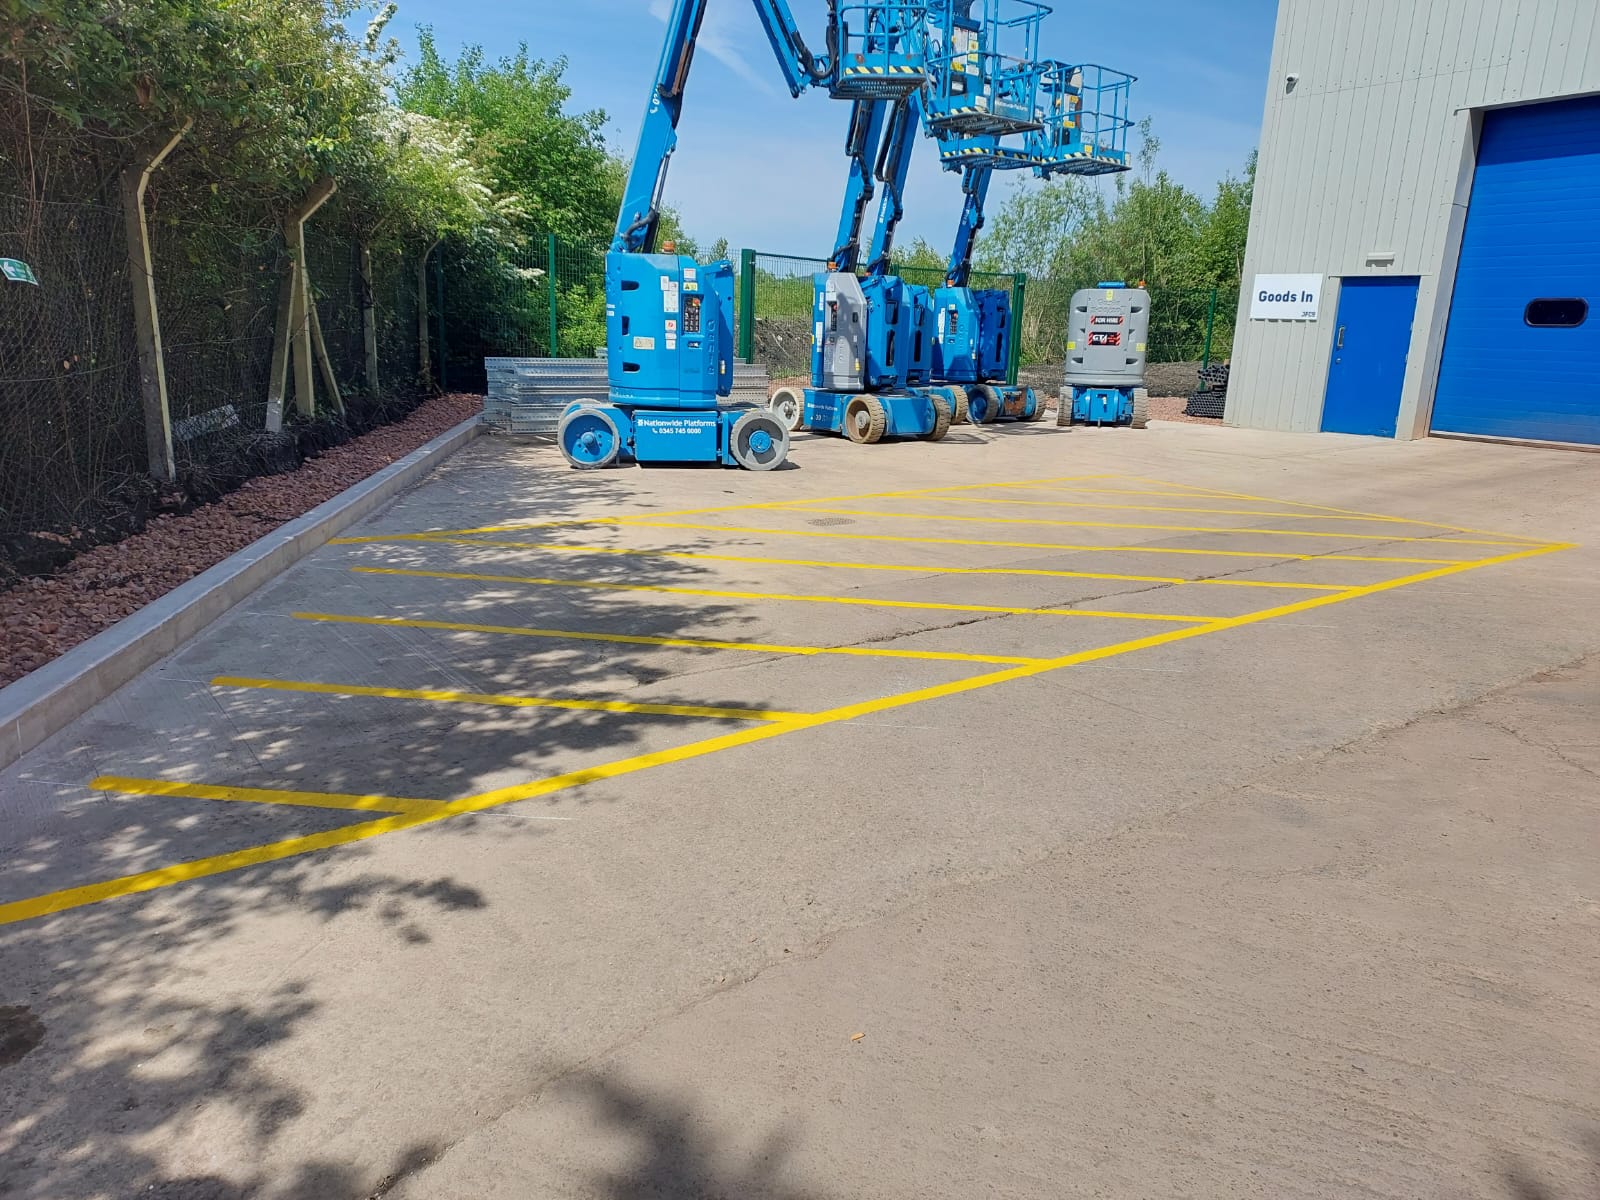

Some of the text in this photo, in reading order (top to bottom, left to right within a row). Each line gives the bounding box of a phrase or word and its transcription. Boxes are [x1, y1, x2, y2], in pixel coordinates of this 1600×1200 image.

[1258, 290, 1313, 303] Goods In
[643, 419, 717, 427] Nationwide Platforms
